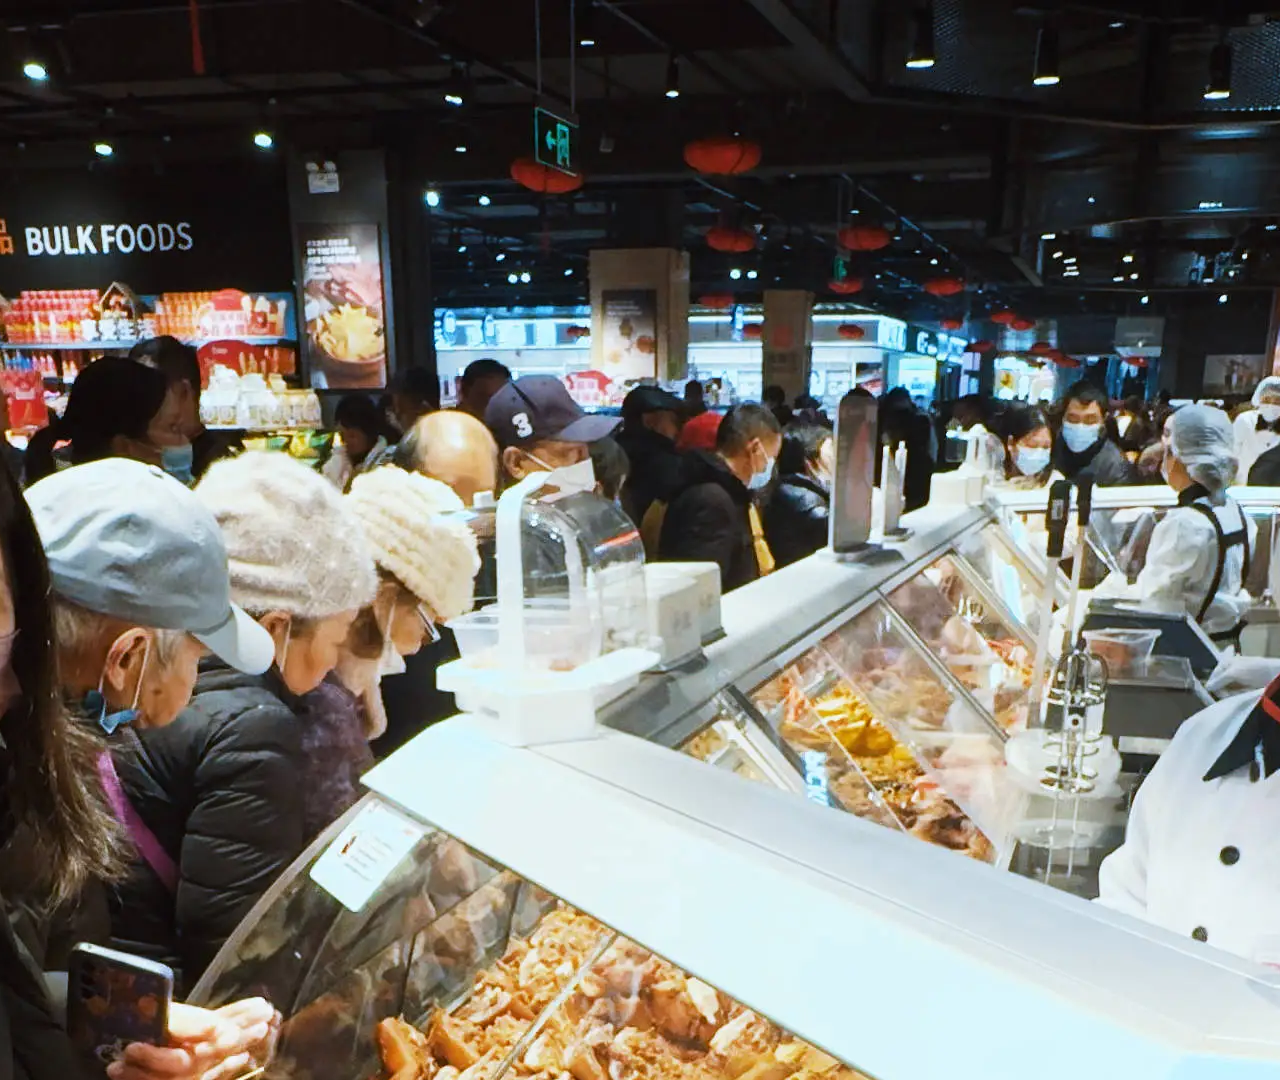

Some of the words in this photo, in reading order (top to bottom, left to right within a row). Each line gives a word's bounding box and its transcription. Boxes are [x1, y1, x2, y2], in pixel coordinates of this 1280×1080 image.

[25, 224, 96, 256] BULK
[100, 222, 194, 255] FOODS
[511, 412, 533, 438] 3
